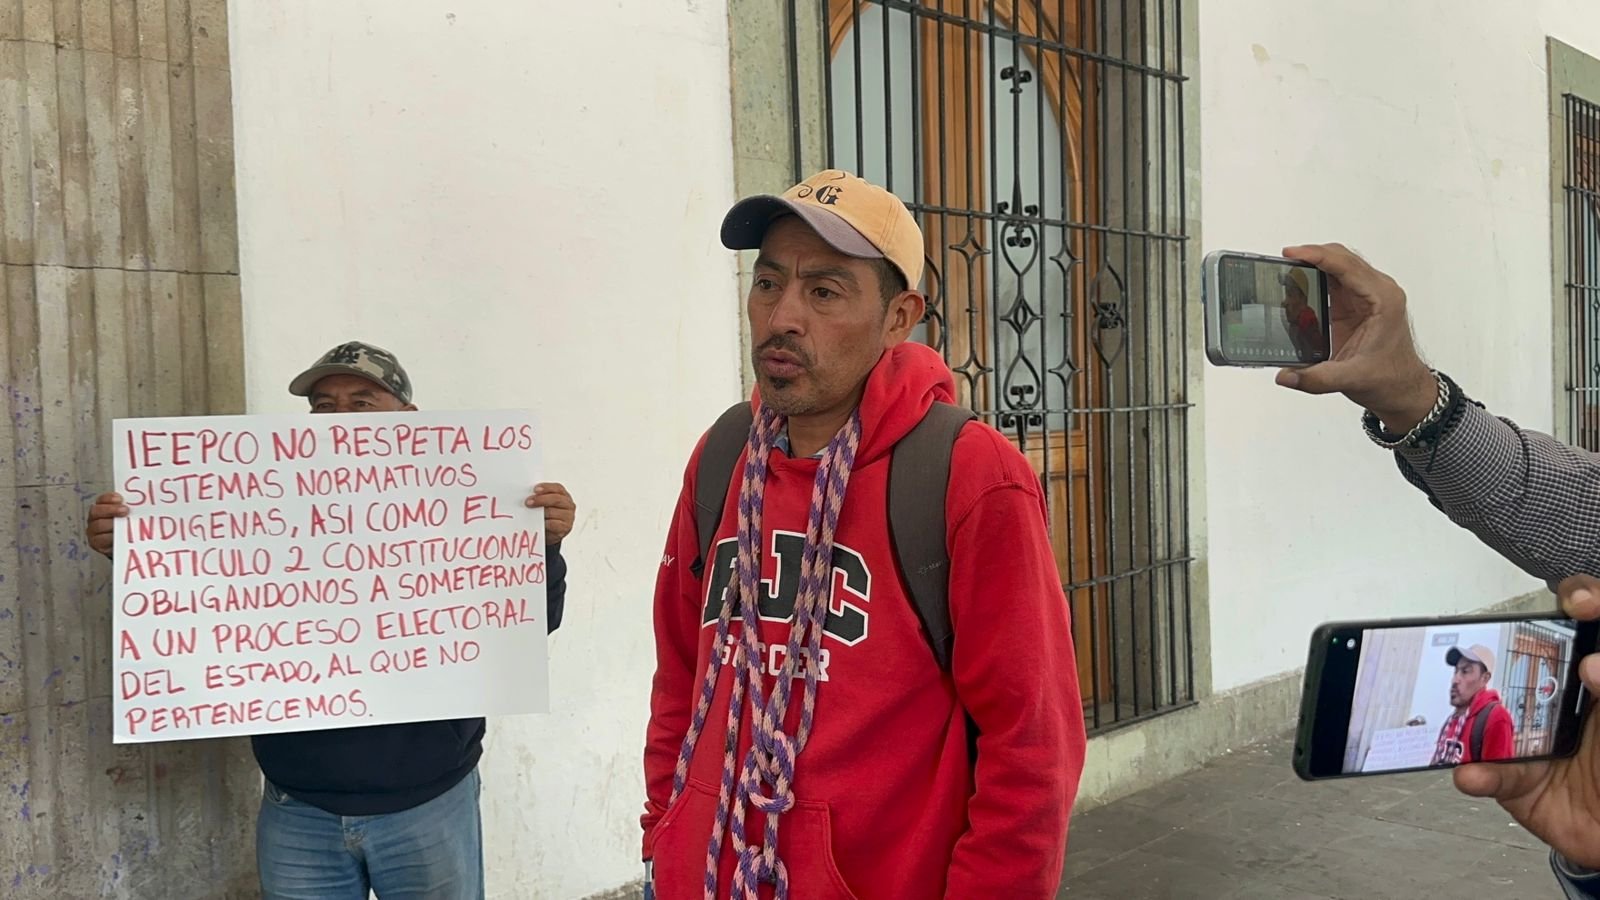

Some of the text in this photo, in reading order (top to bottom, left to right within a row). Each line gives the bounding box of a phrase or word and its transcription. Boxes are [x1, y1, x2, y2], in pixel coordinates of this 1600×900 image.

[127, 424, 533, 469] IEEPCO NO RESPETA LOS
[123, 463, 478, 506] SISTEMAS NORMATIVOS
[126, 495, 514, 544] INDIGENAS, ASI COMO EL
[123, 530, 544, 584] ARTICULO 2 CONSTITUCIONAL
[121, 562, 546, 617] OBLIGANDONOS A SOMETERNOS
[120, 598, 536, 661] A UN PROCESO ELECTORAL
[121, 640, 481, 700] DEL ESTADO, AL QUE NO
[125, 689, 375, 735] PERTENECEMOS.
